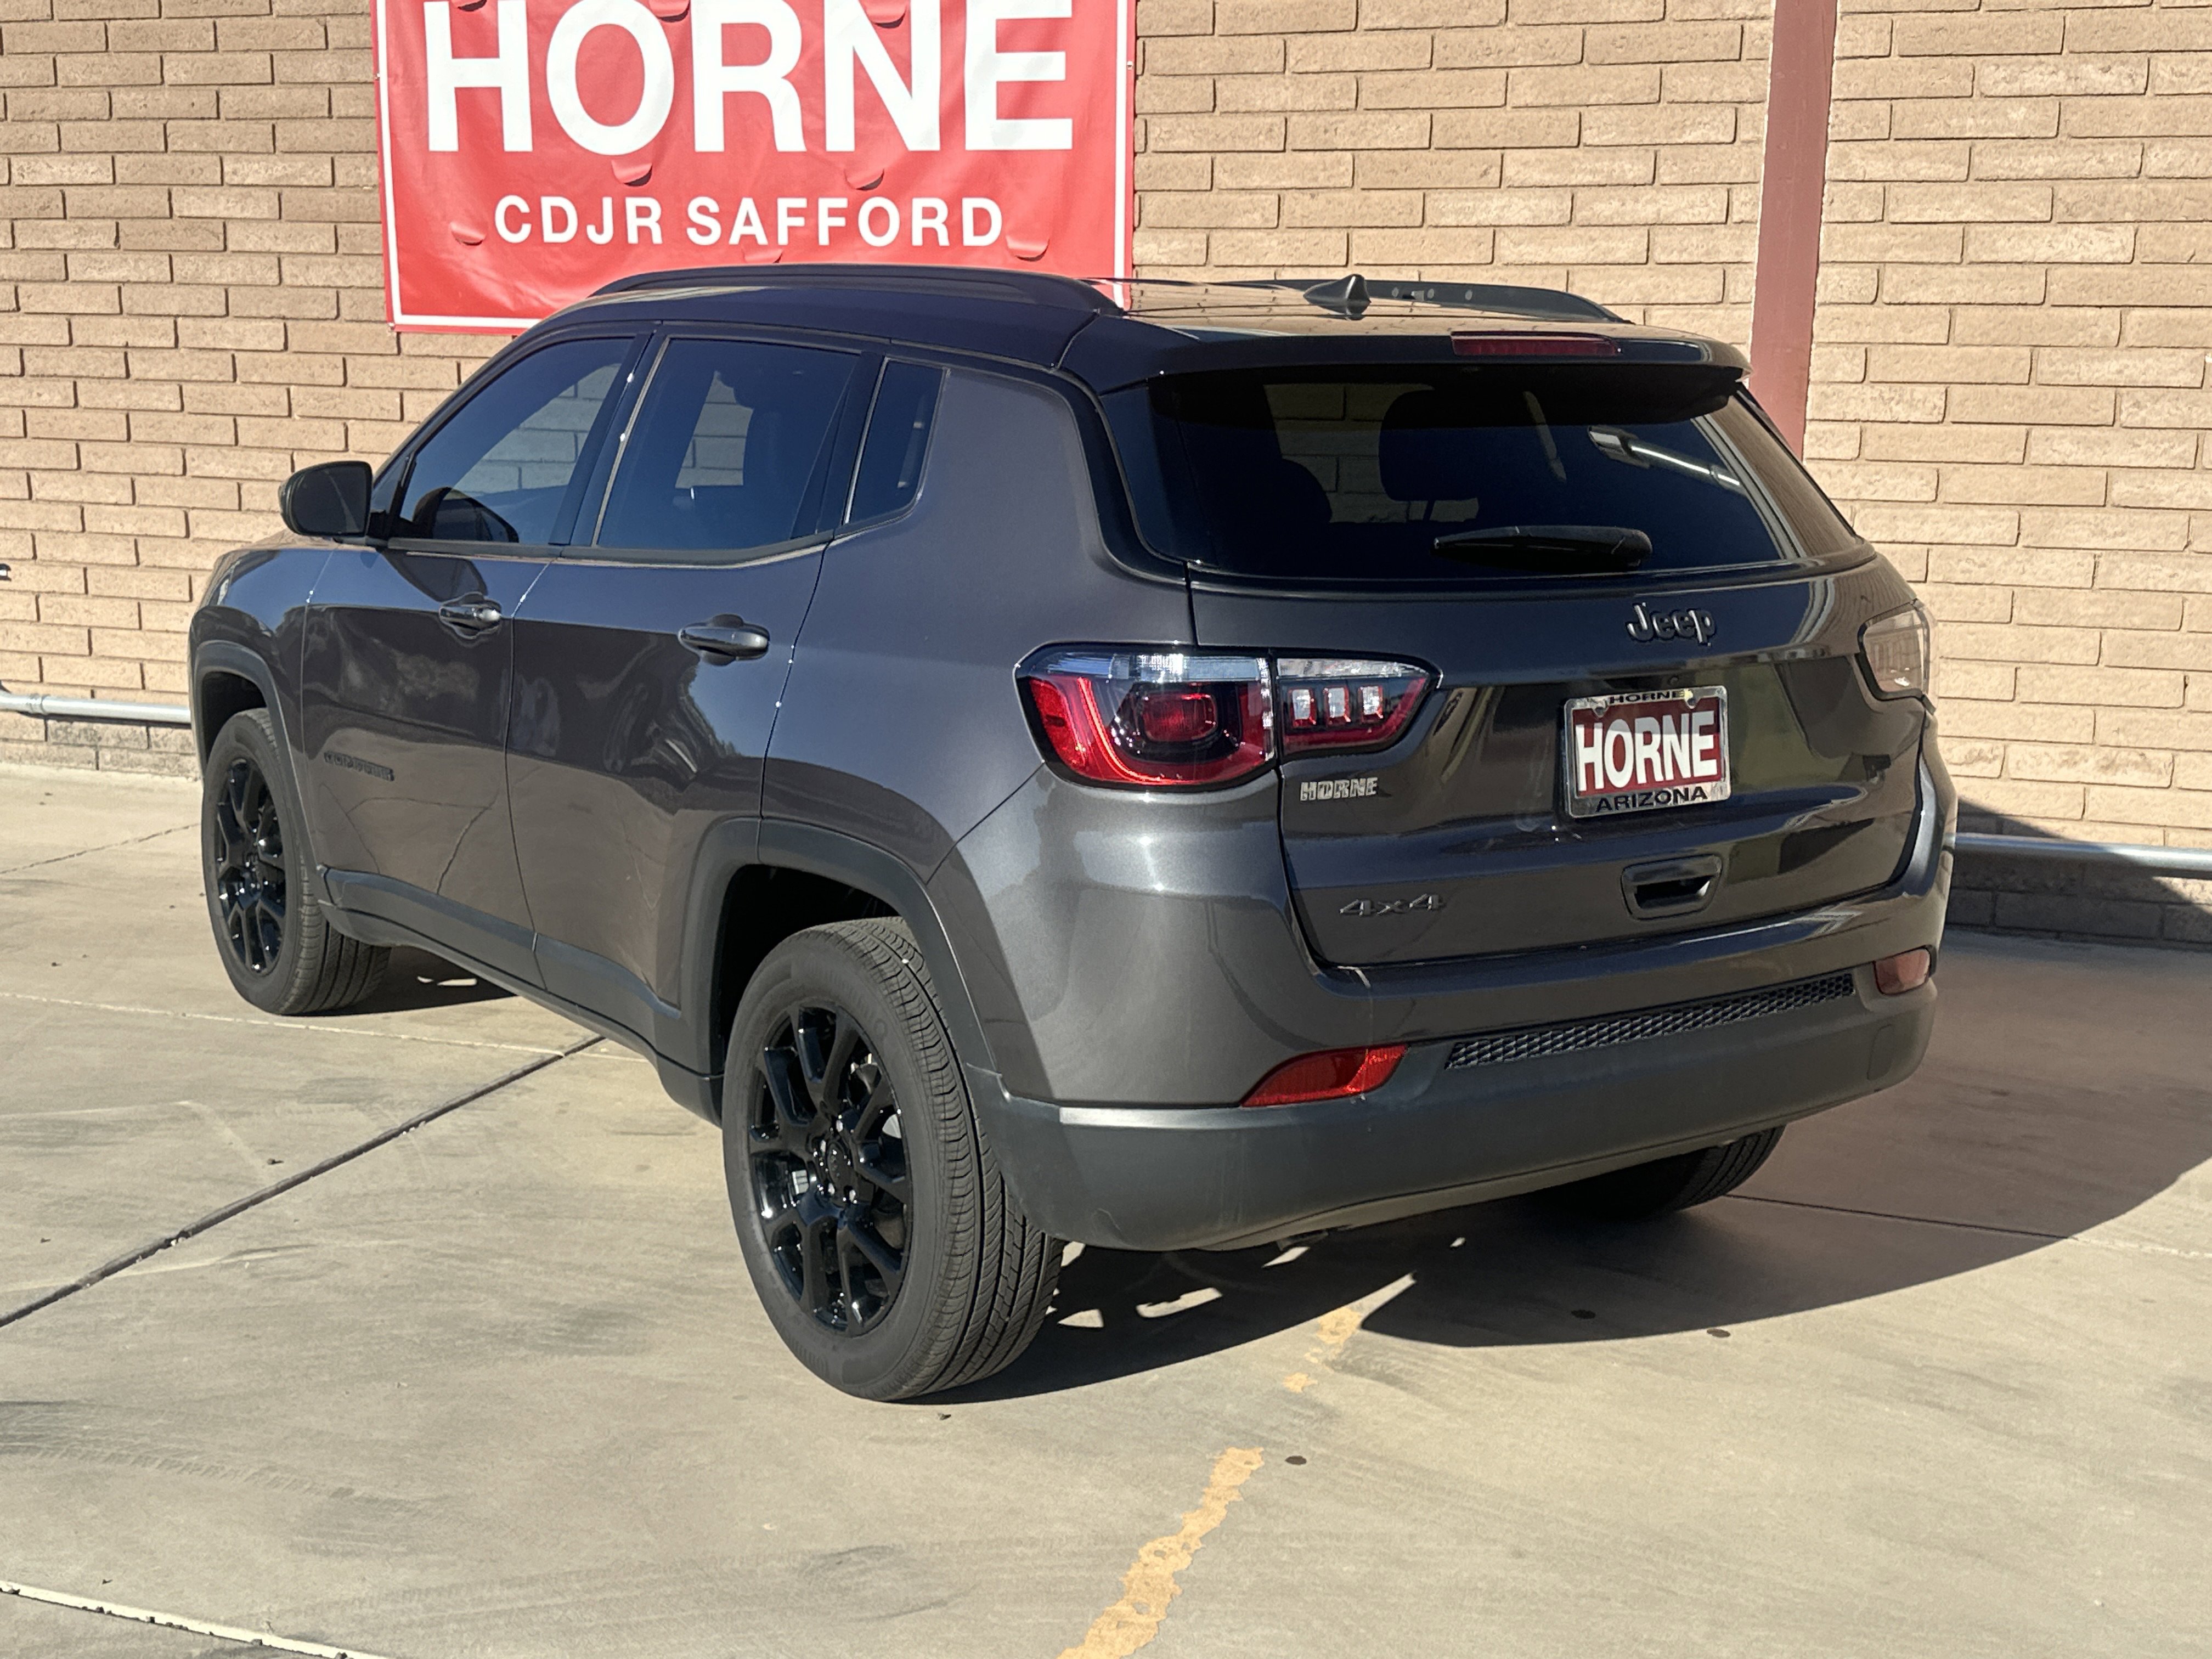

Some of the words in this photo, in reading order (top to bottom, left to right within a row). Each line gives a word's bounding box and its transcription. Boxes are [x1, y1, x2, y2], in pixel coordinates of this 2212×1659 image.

[424, 0, 1073, 155] HORNE
[494, 195, 662, 245] CDJR
[687, 197, 1003, 247] SAFFORD
[1626, 603, 1717, 646] Jeep
[1609, 690, 1685, 704] HORNE
[1576, 710, 1718, 791] HORNE
[1300, 777, 1379, 801] HORNE
[1595, 786, 1708, 812] ARIZONA
[1339, 894, 1445, 917] 4x4
